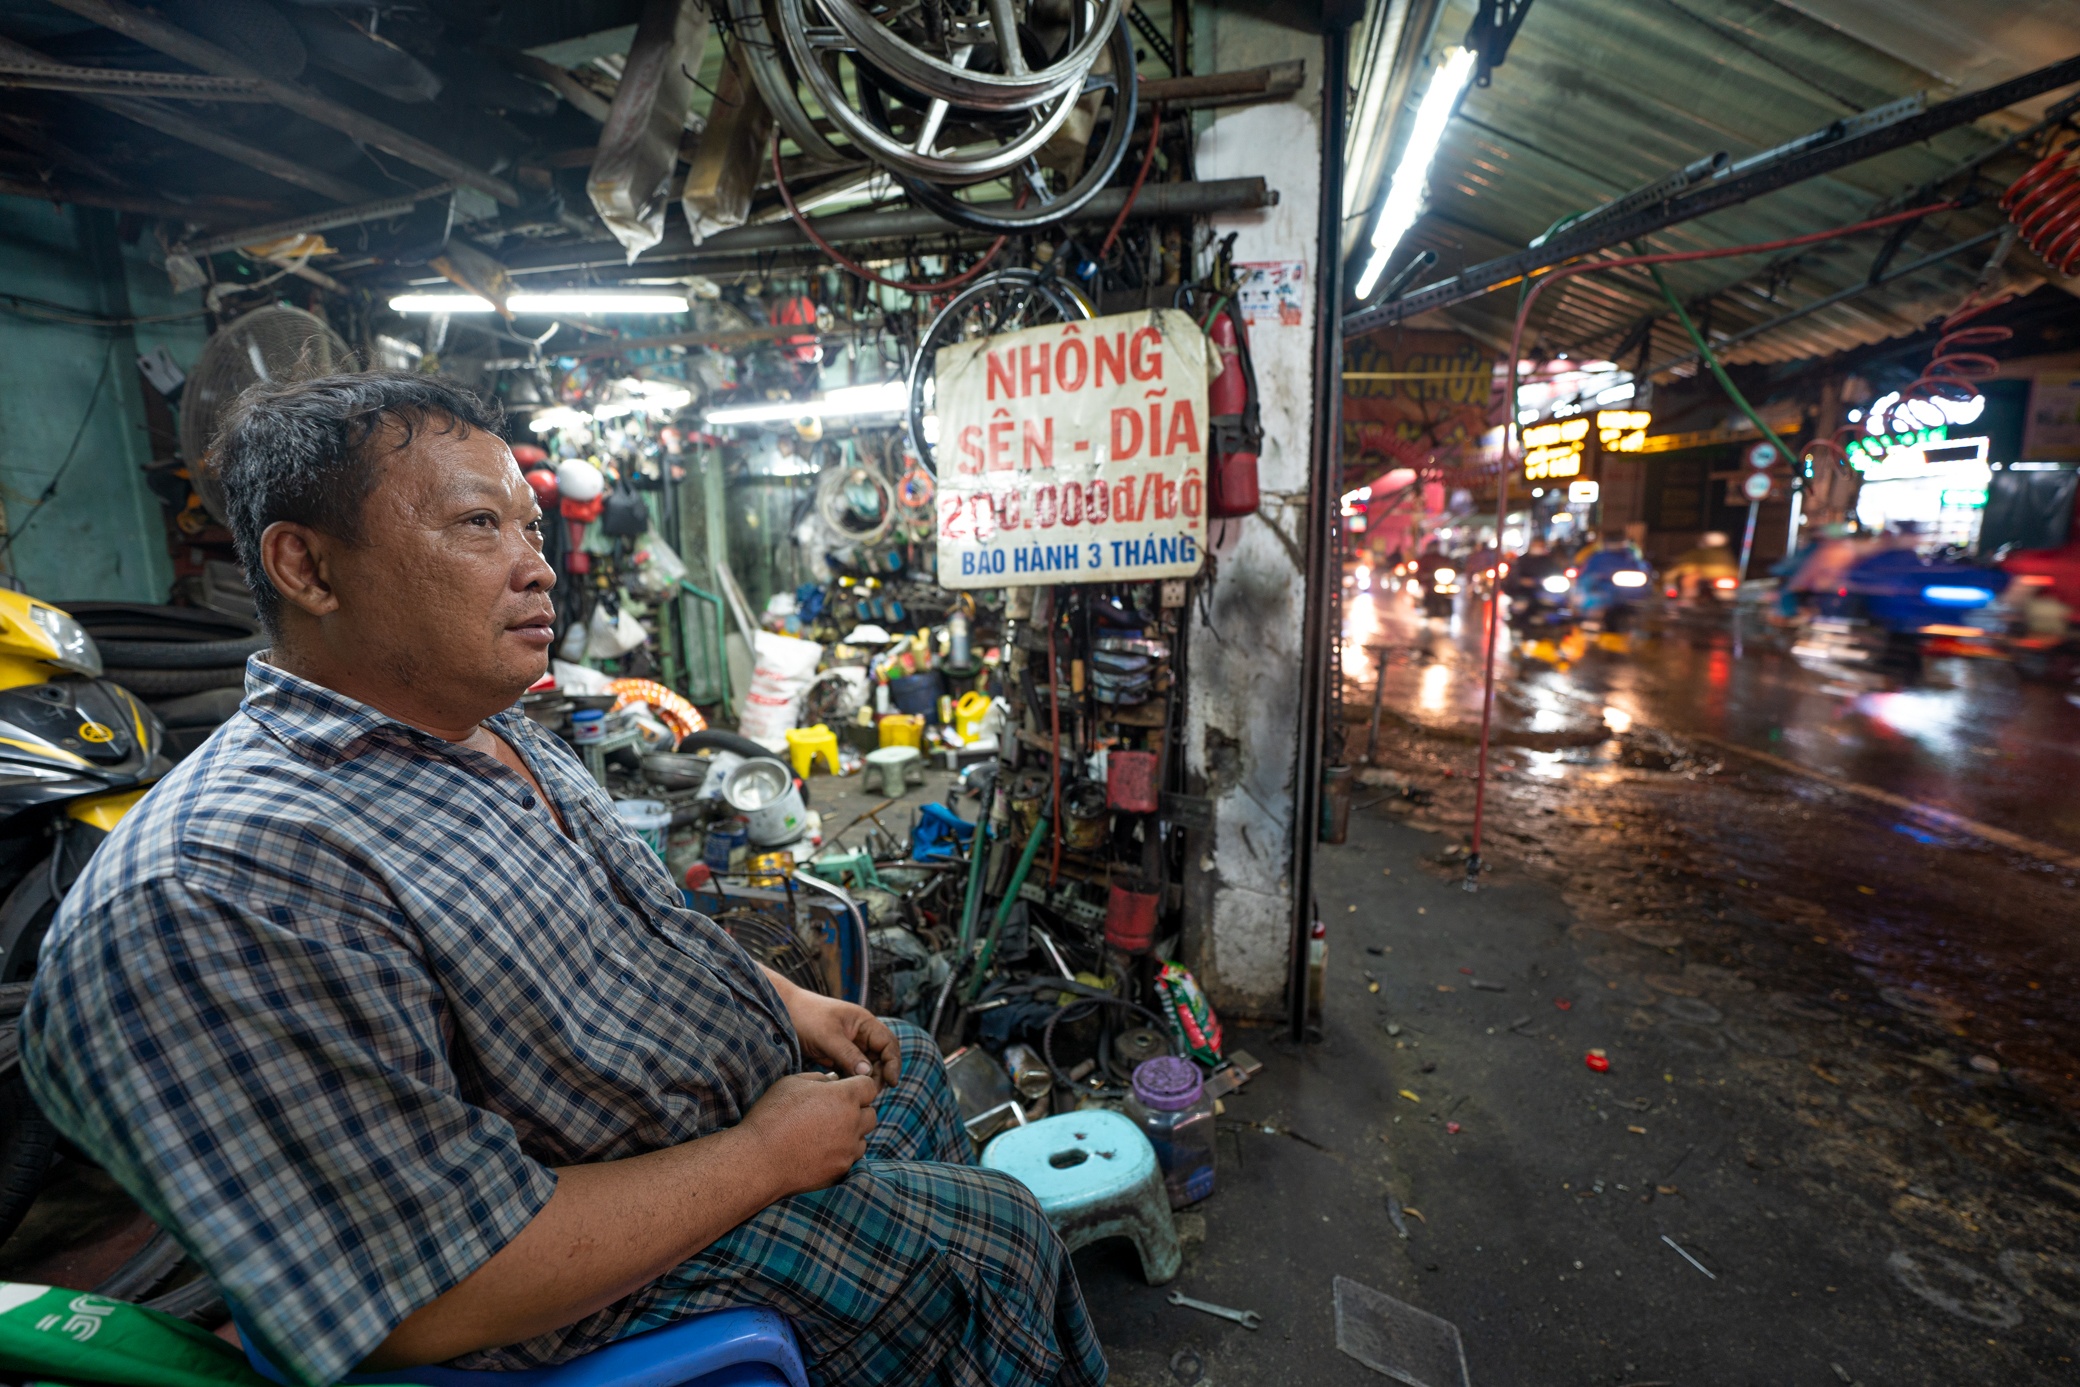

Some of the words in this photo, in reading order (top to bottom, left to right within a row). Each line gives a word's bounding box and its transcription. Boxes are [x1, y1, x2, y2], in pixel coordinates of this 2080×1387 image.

[987, 323, 1163, 400] NHÔNG
[958, 408, 1054, 475] SÊN
[1110, 387, 1200, 461] DĨA
[1014, 541, 1079, 573] HÀNH
[1088, 543, 1101, 568] 3
[1110, 533, 1197, 568] THÁNG
